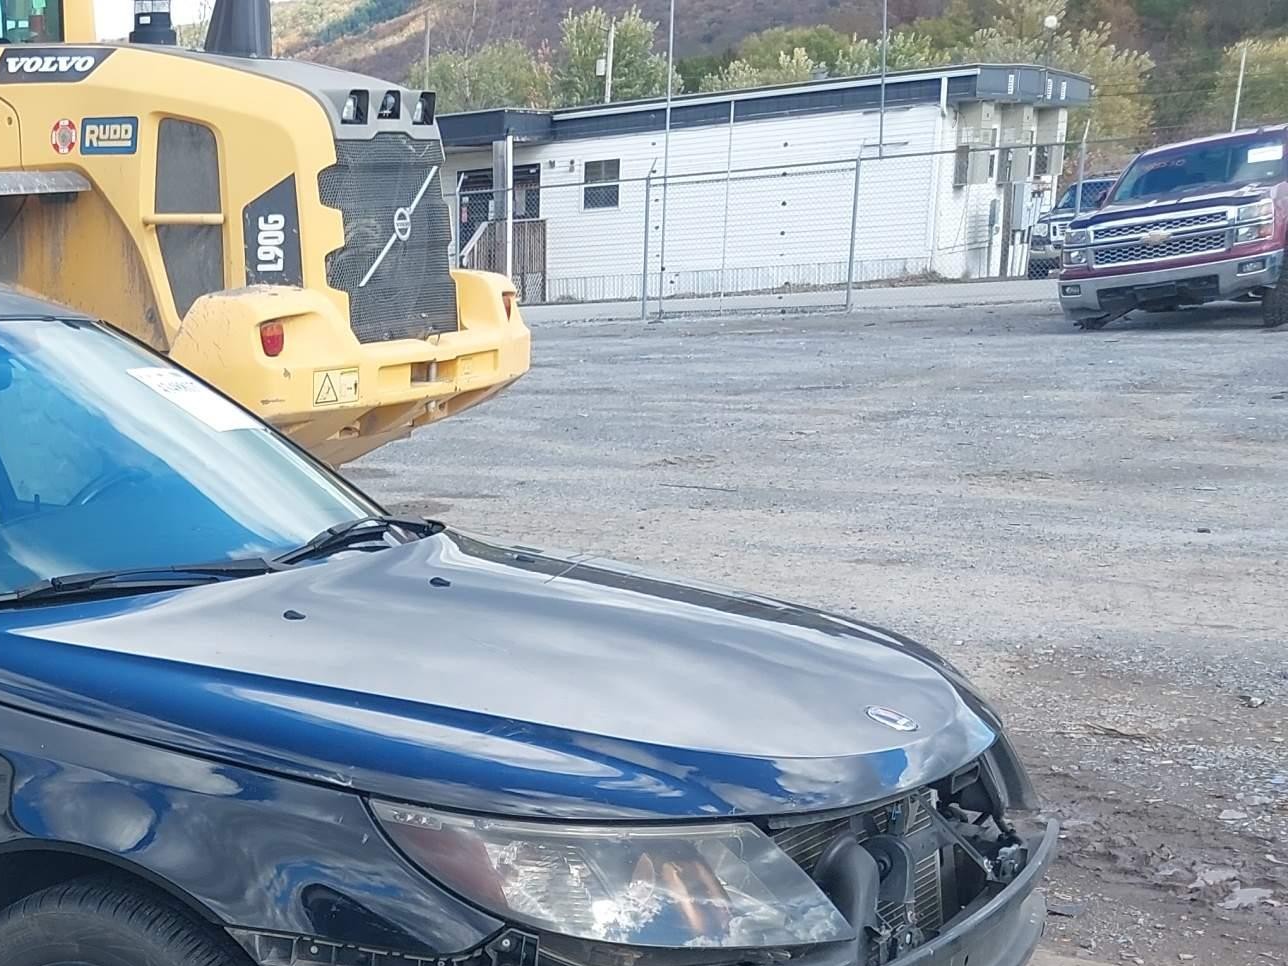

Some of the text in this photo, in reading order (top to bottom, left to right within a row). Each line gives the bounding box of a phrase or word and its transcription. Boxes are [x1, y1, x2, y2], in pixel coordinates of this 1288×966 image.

[6, 56, 95, 73] VOLVO
[85, 123, 133, 148] RUDD
[257, 214, 285, 272] L90G
